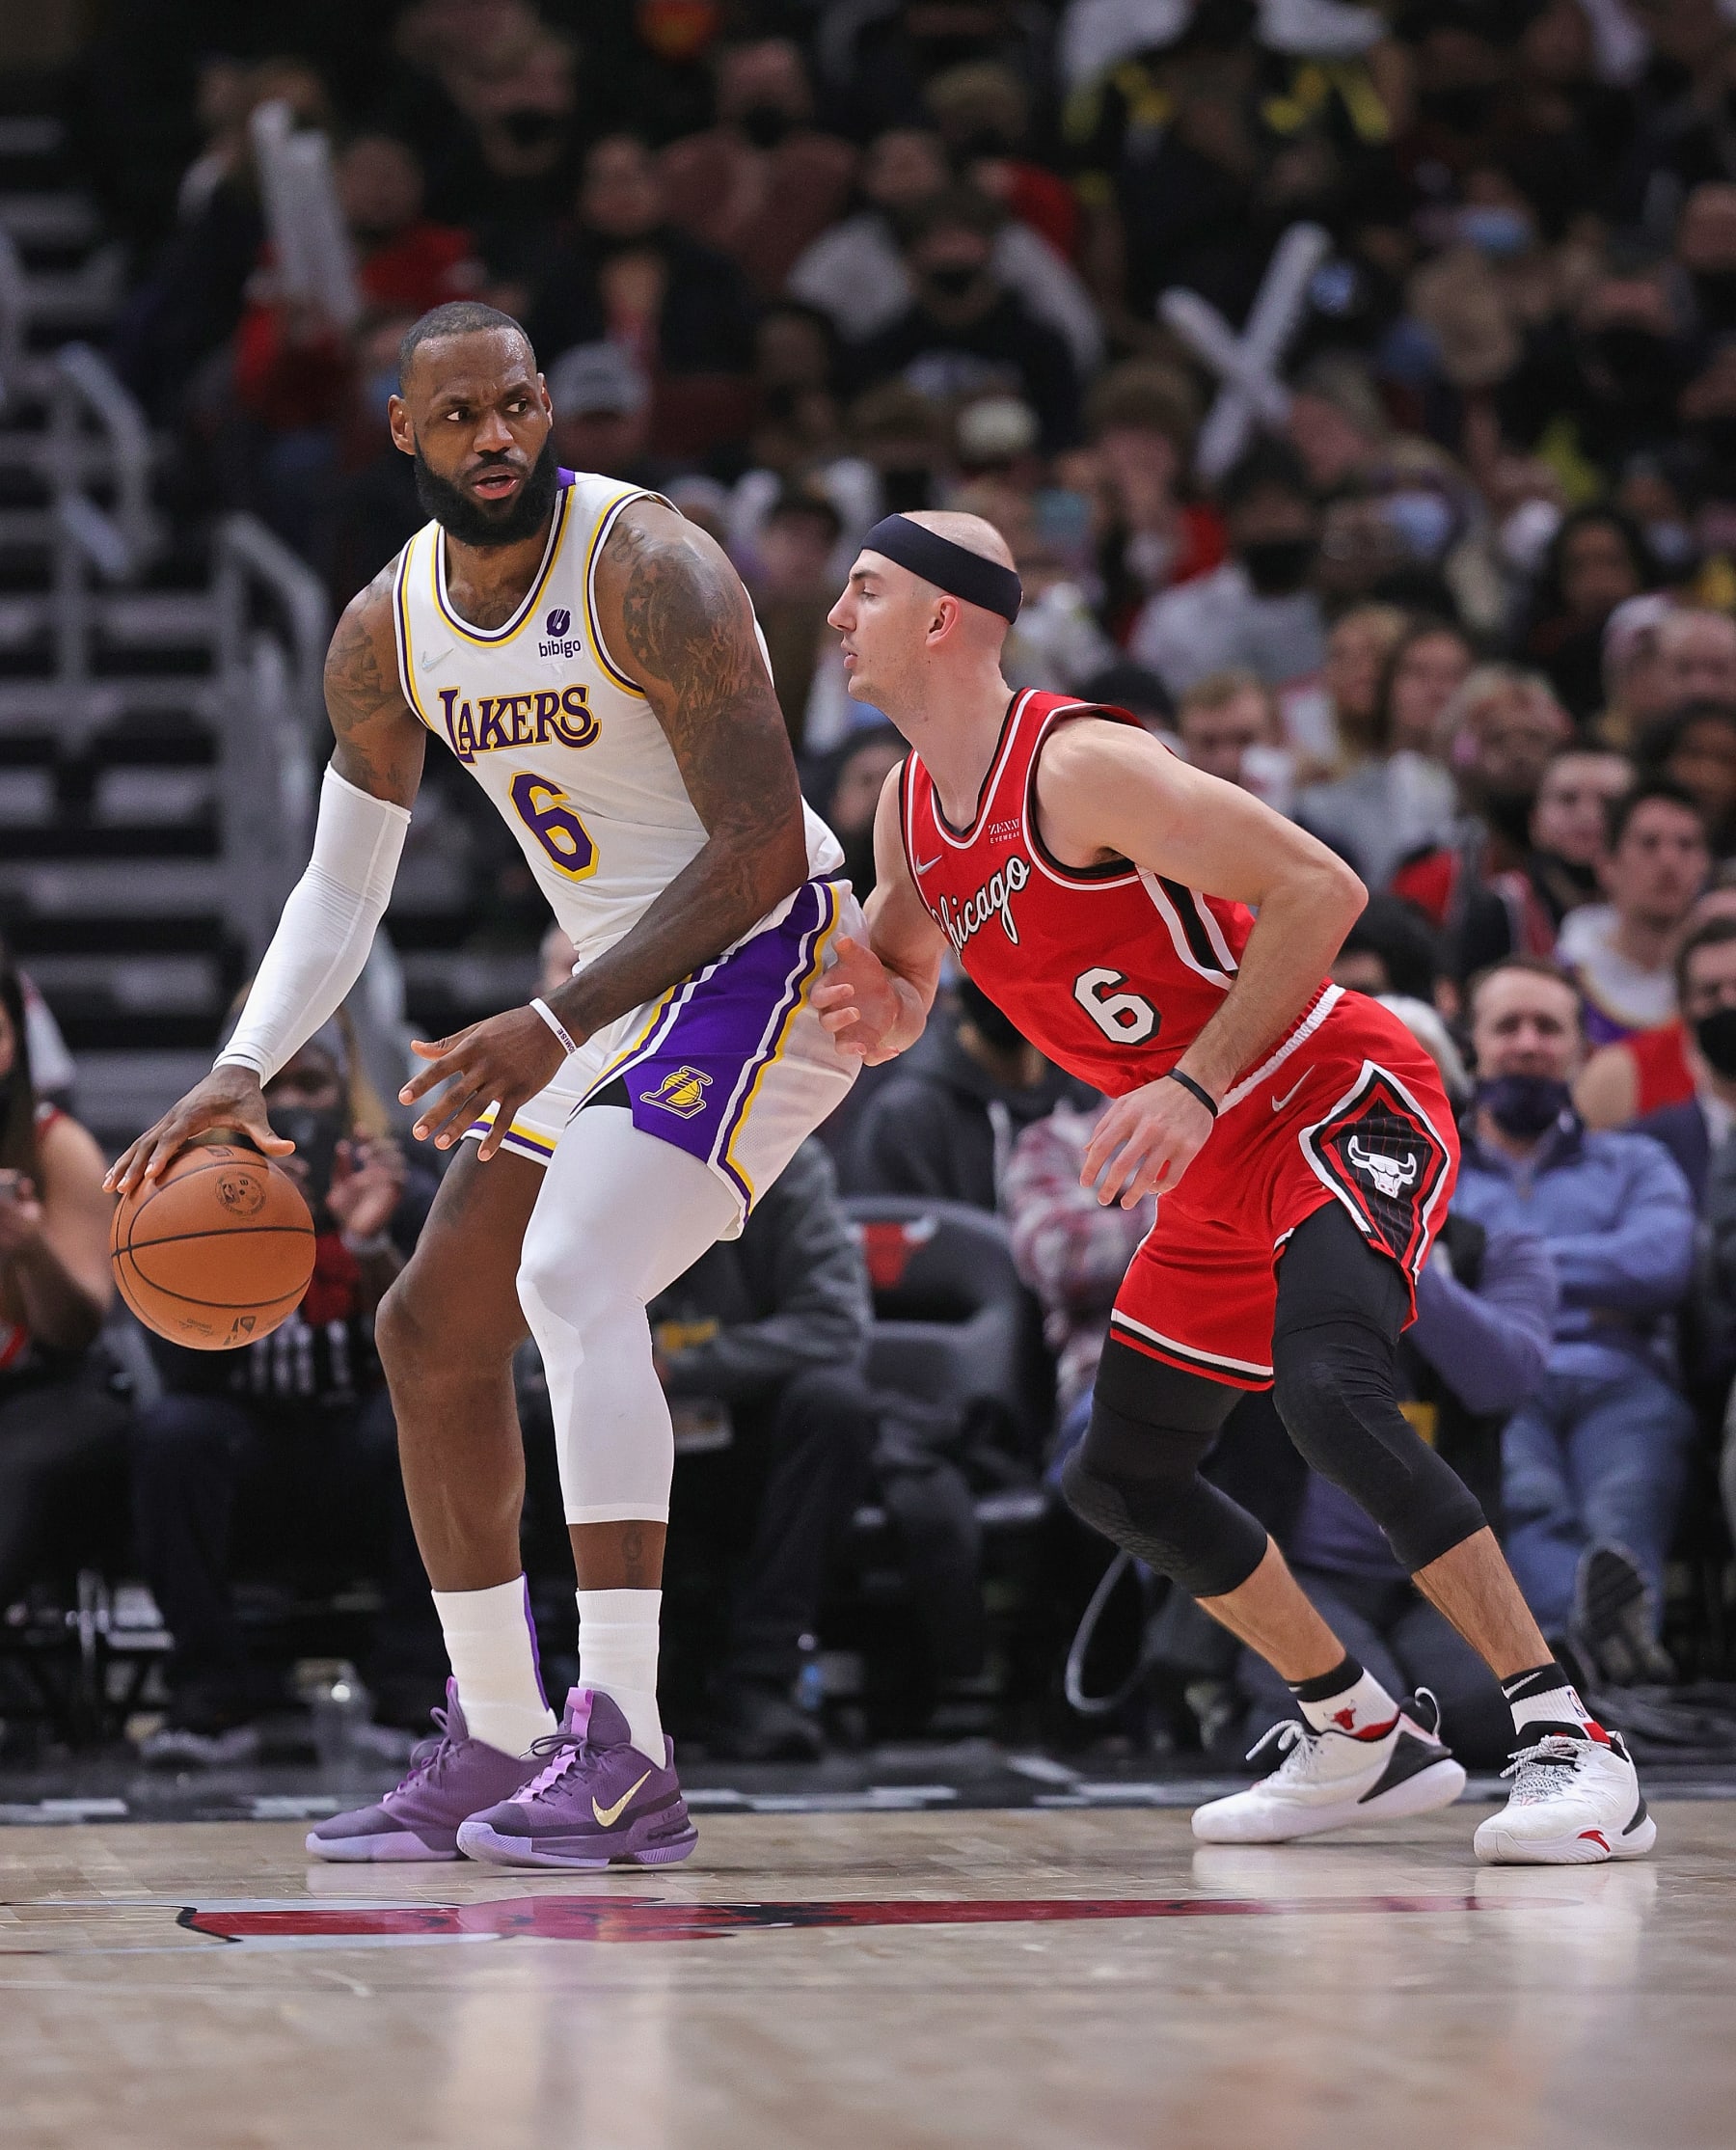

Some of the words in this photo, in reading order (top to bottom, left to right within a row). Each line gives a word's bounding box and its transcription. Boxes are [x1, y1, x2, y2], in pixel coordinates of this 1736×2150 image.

[538, 639, 582, 659] bibigo
[438, 684, 602, 765] LAKERS
[508, 771, 600, 882] 6
[990, 830, 1019, 844] EYEWEAR
[931, 855, 1031, 955] hicago
[1073, 966, 1162, 1046] 6
